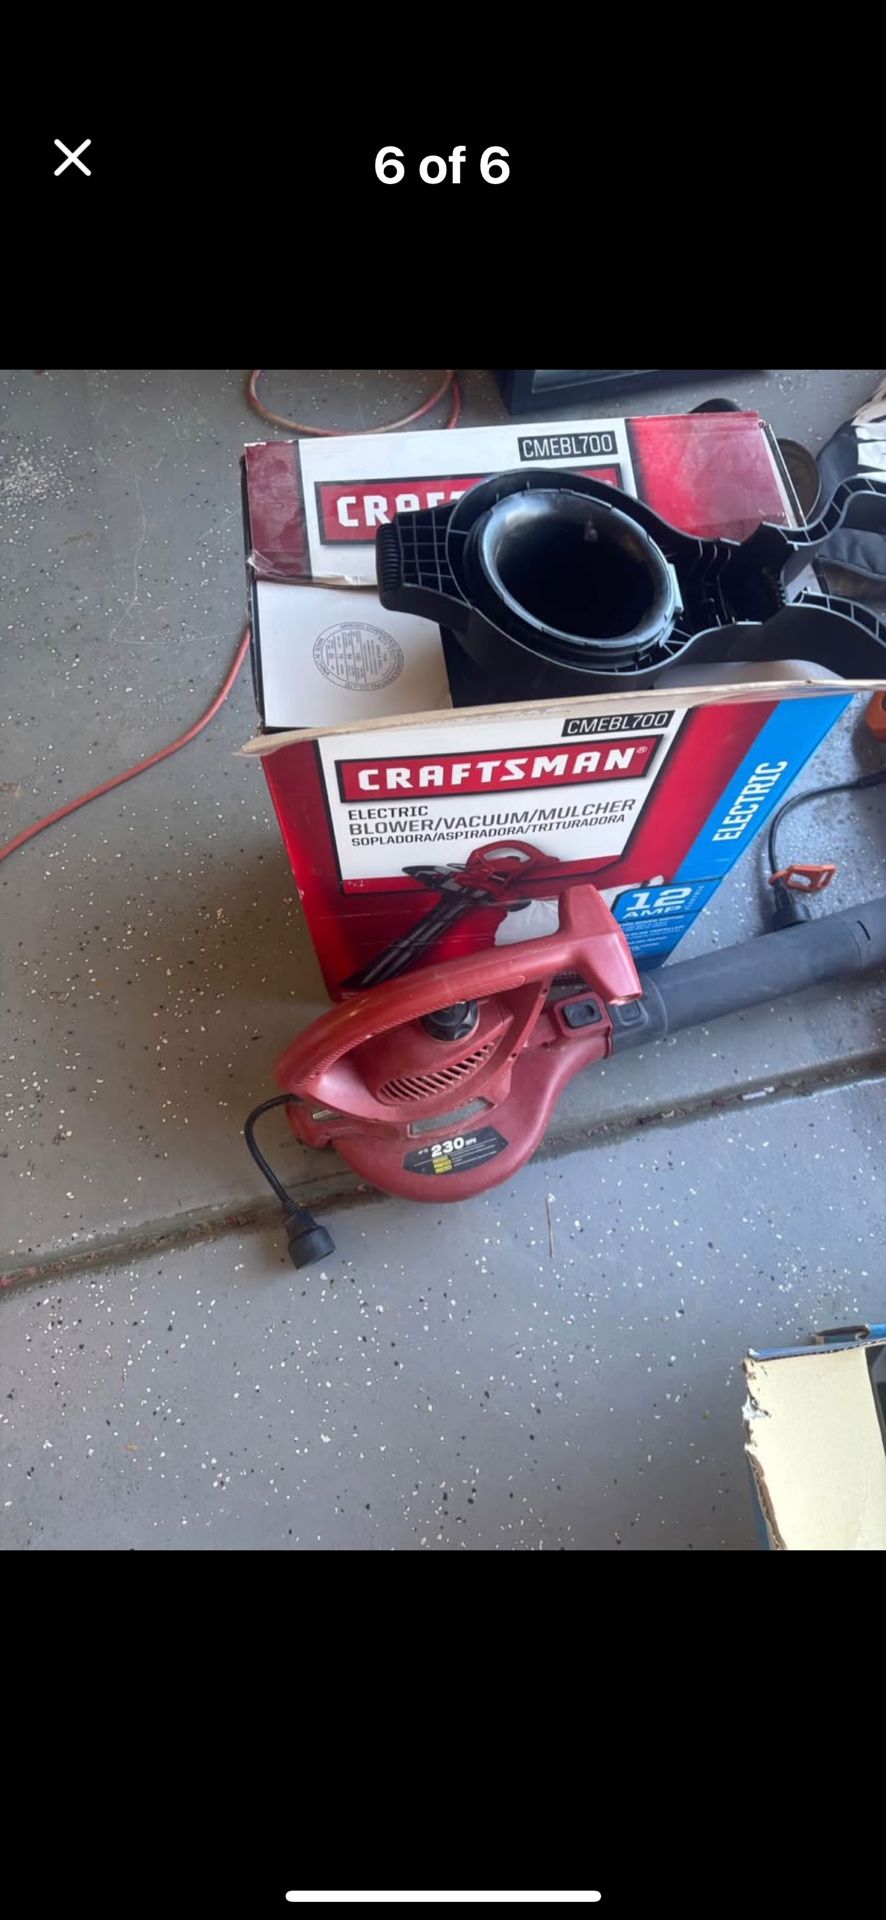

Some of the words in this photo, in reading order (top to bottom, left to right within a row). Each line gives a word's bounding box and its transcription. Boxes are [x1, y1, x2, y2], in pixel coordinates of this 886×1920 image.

[522, 434, 613, 458] CMEBL700
[567, 712, 669, 734] CMEBL700
[348, 805, 429, 820] ELECTRIC
[712, 761, 788, 841] ELECTRIC
[350, 799, 637, 836] BLOWER/VACUUM/MULCHER
[352, 814, 625, 846] SOPLADORA/ASPIRADORA/TRITURADORA
[626, 887, 692, 911] 12
[622, 905, 682, 919] AMP
[431, 1137, 464, 1157] 230
